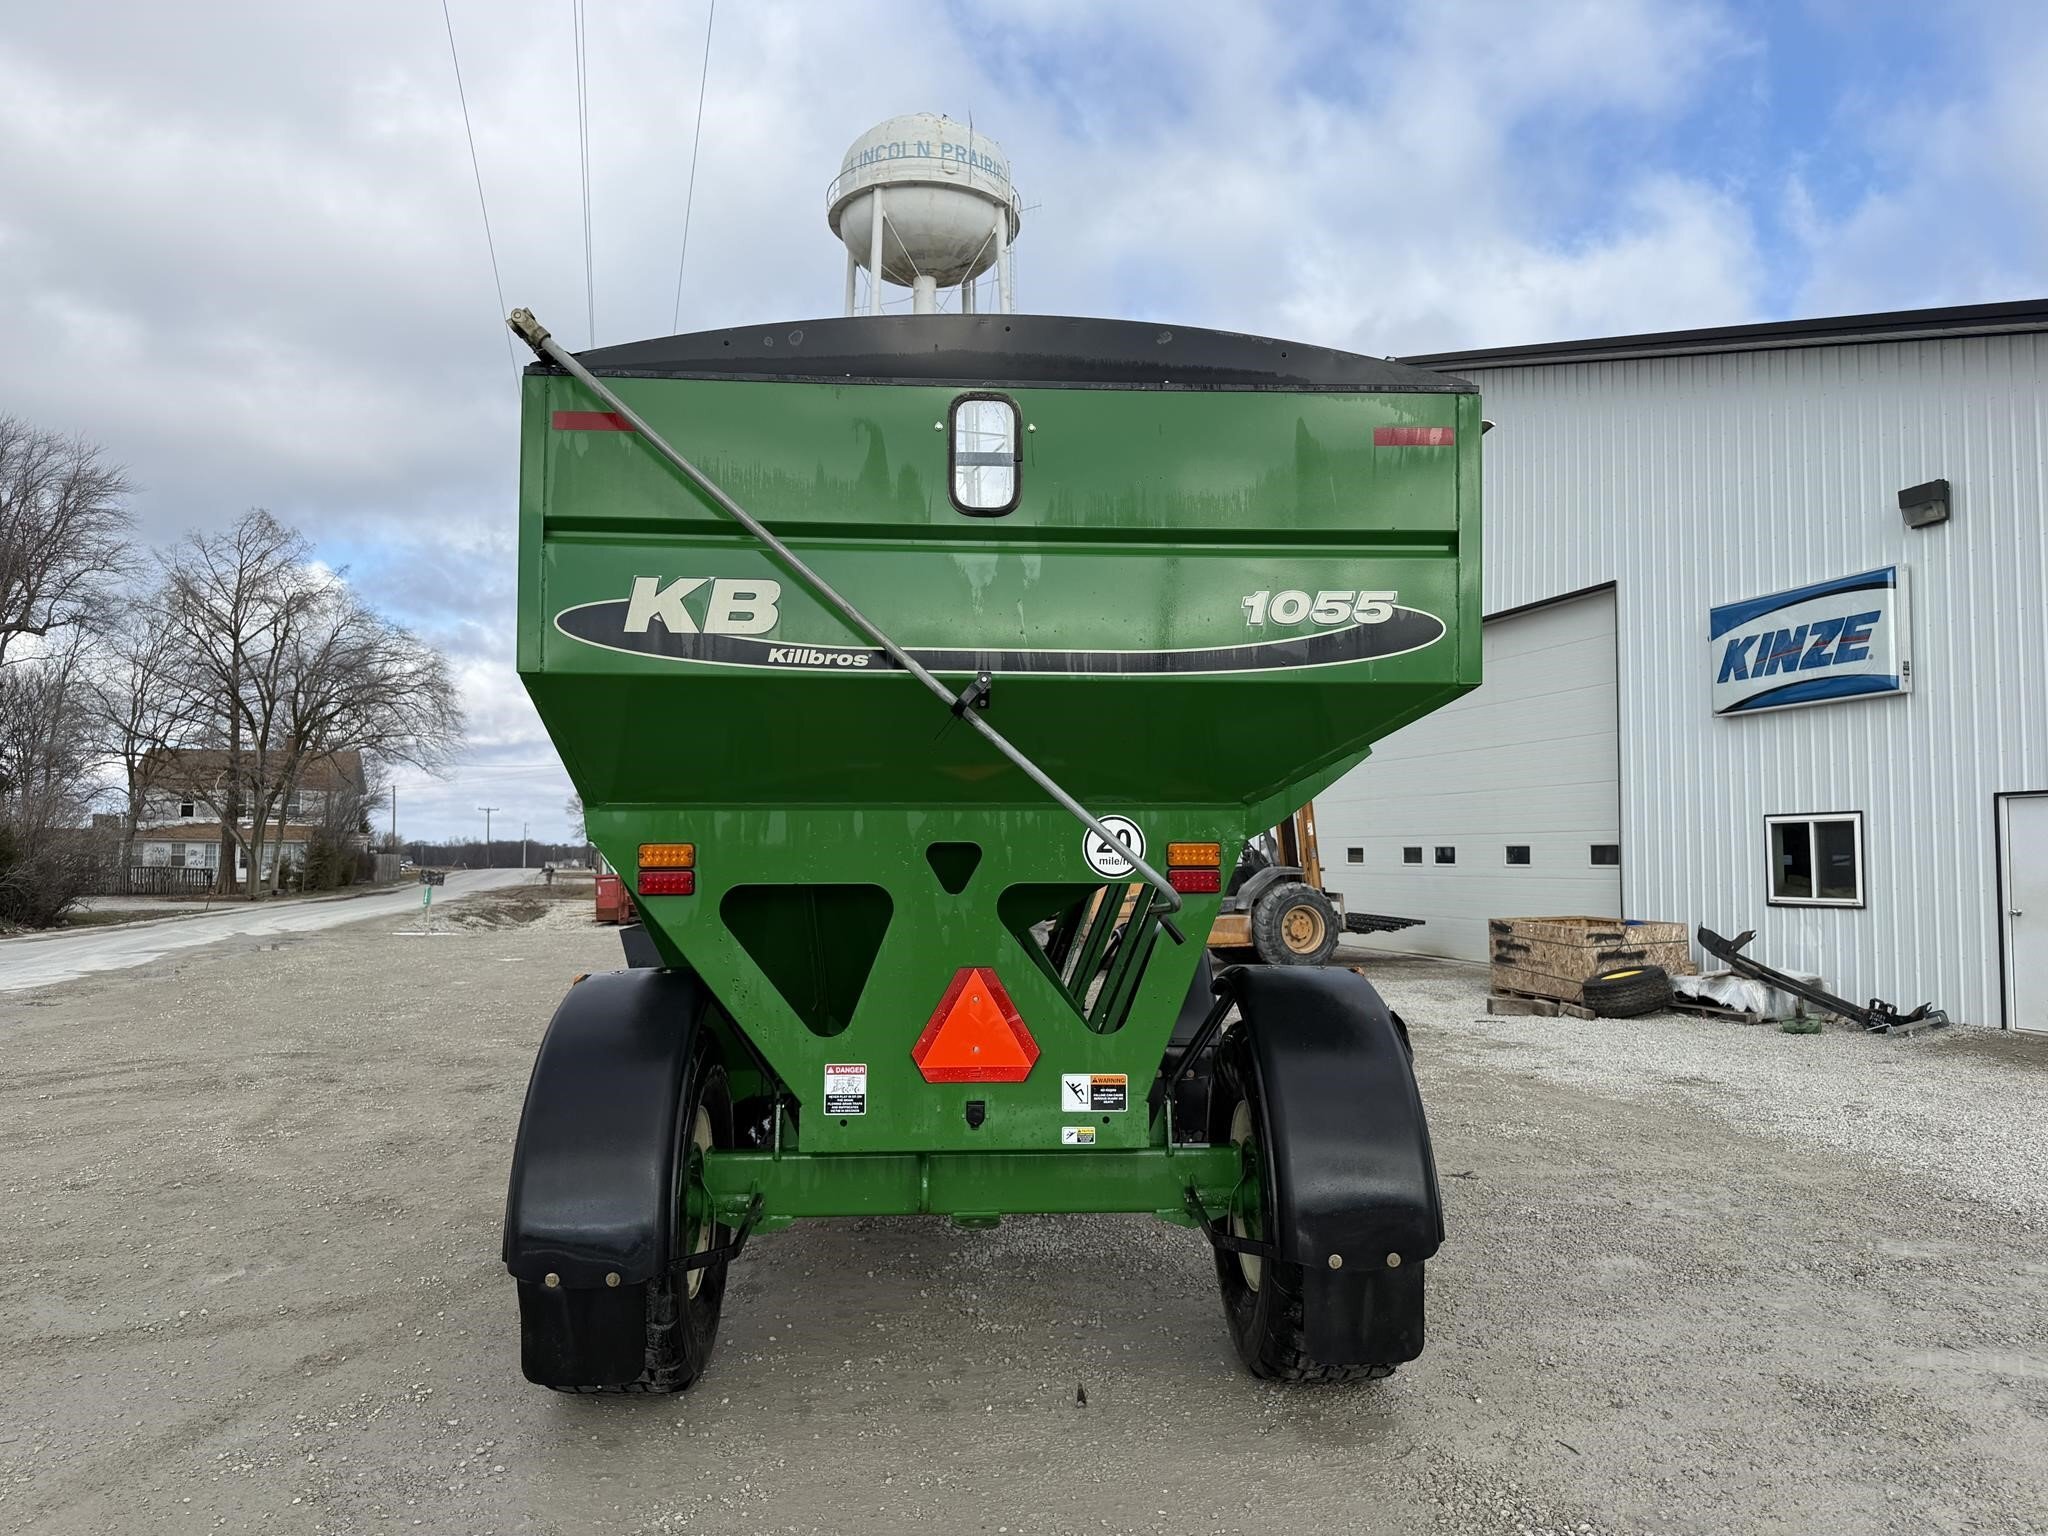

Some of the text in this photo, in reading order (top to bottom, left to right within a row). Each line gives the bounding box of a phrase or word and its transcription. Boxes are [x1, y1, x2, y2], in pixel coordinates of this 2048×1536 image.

[850, 140, 930, 173] LINCOLN
[623, 575, 781, 635] KB
[1241, 590, 1398, 626] 1055
[767, 648, 869, 667] Killbros
[1717, 609, 1882, 684] KINZE
[835, 1066, 865, 1074] DANGER
